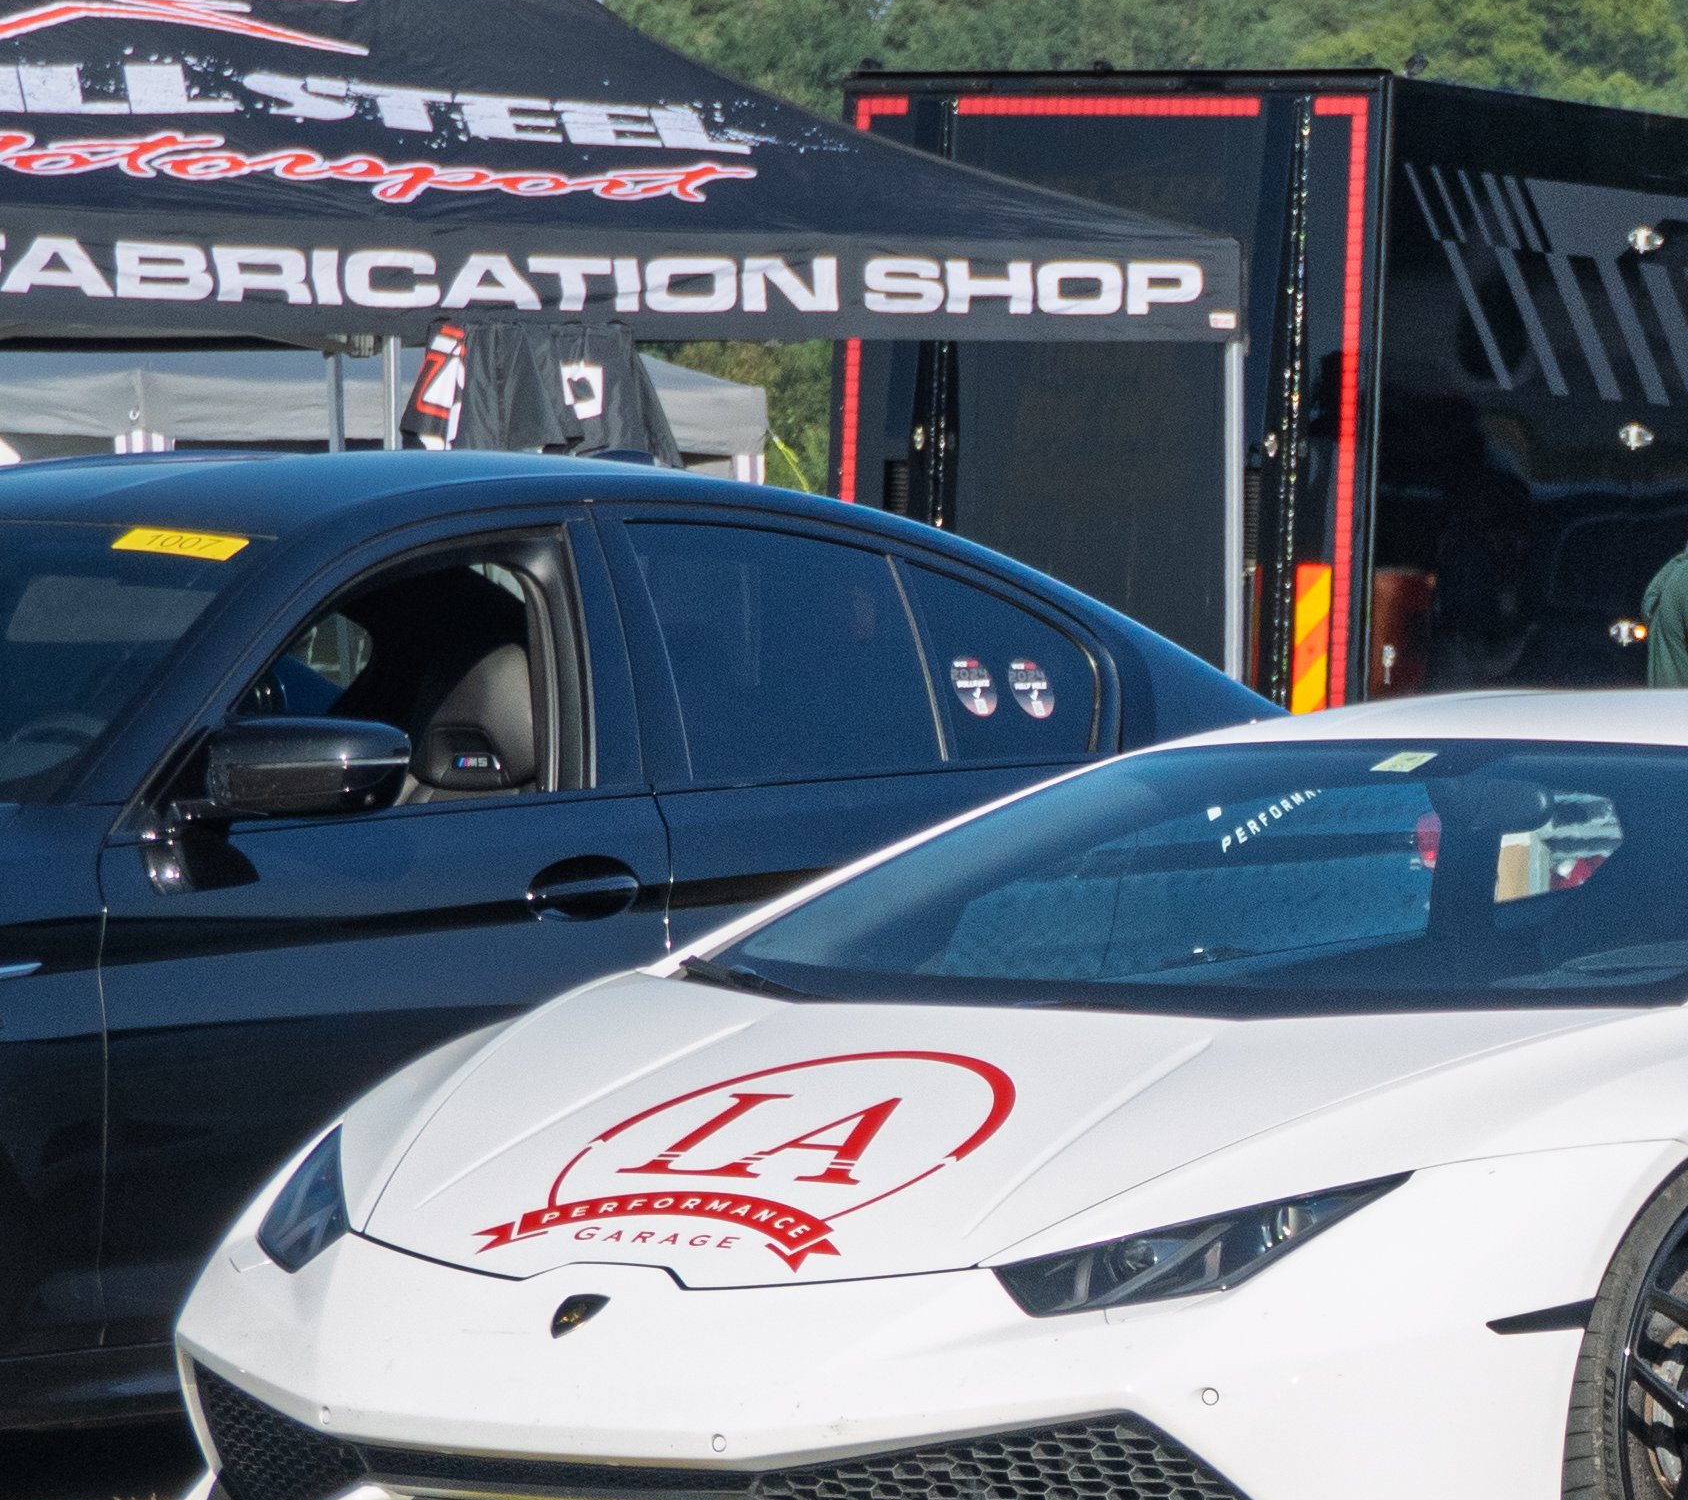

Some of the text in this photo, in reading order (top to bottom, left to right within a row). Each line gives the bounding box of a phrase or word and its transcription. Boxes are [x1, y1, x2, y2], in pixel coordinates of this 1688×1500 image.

[240, 70, 752, 155] STEEL
[0, 232, 1204, 316] ABRICATION SHOP
[146, 533, 224, 552] 1007
[1221, 788, 1323, 854] PERFORMA
[616, 1093, 903, 1185] LA
[540, 1196, 812, 1241] PERFORMANCE
[572, 1225, 743, 1251] GARAGE
